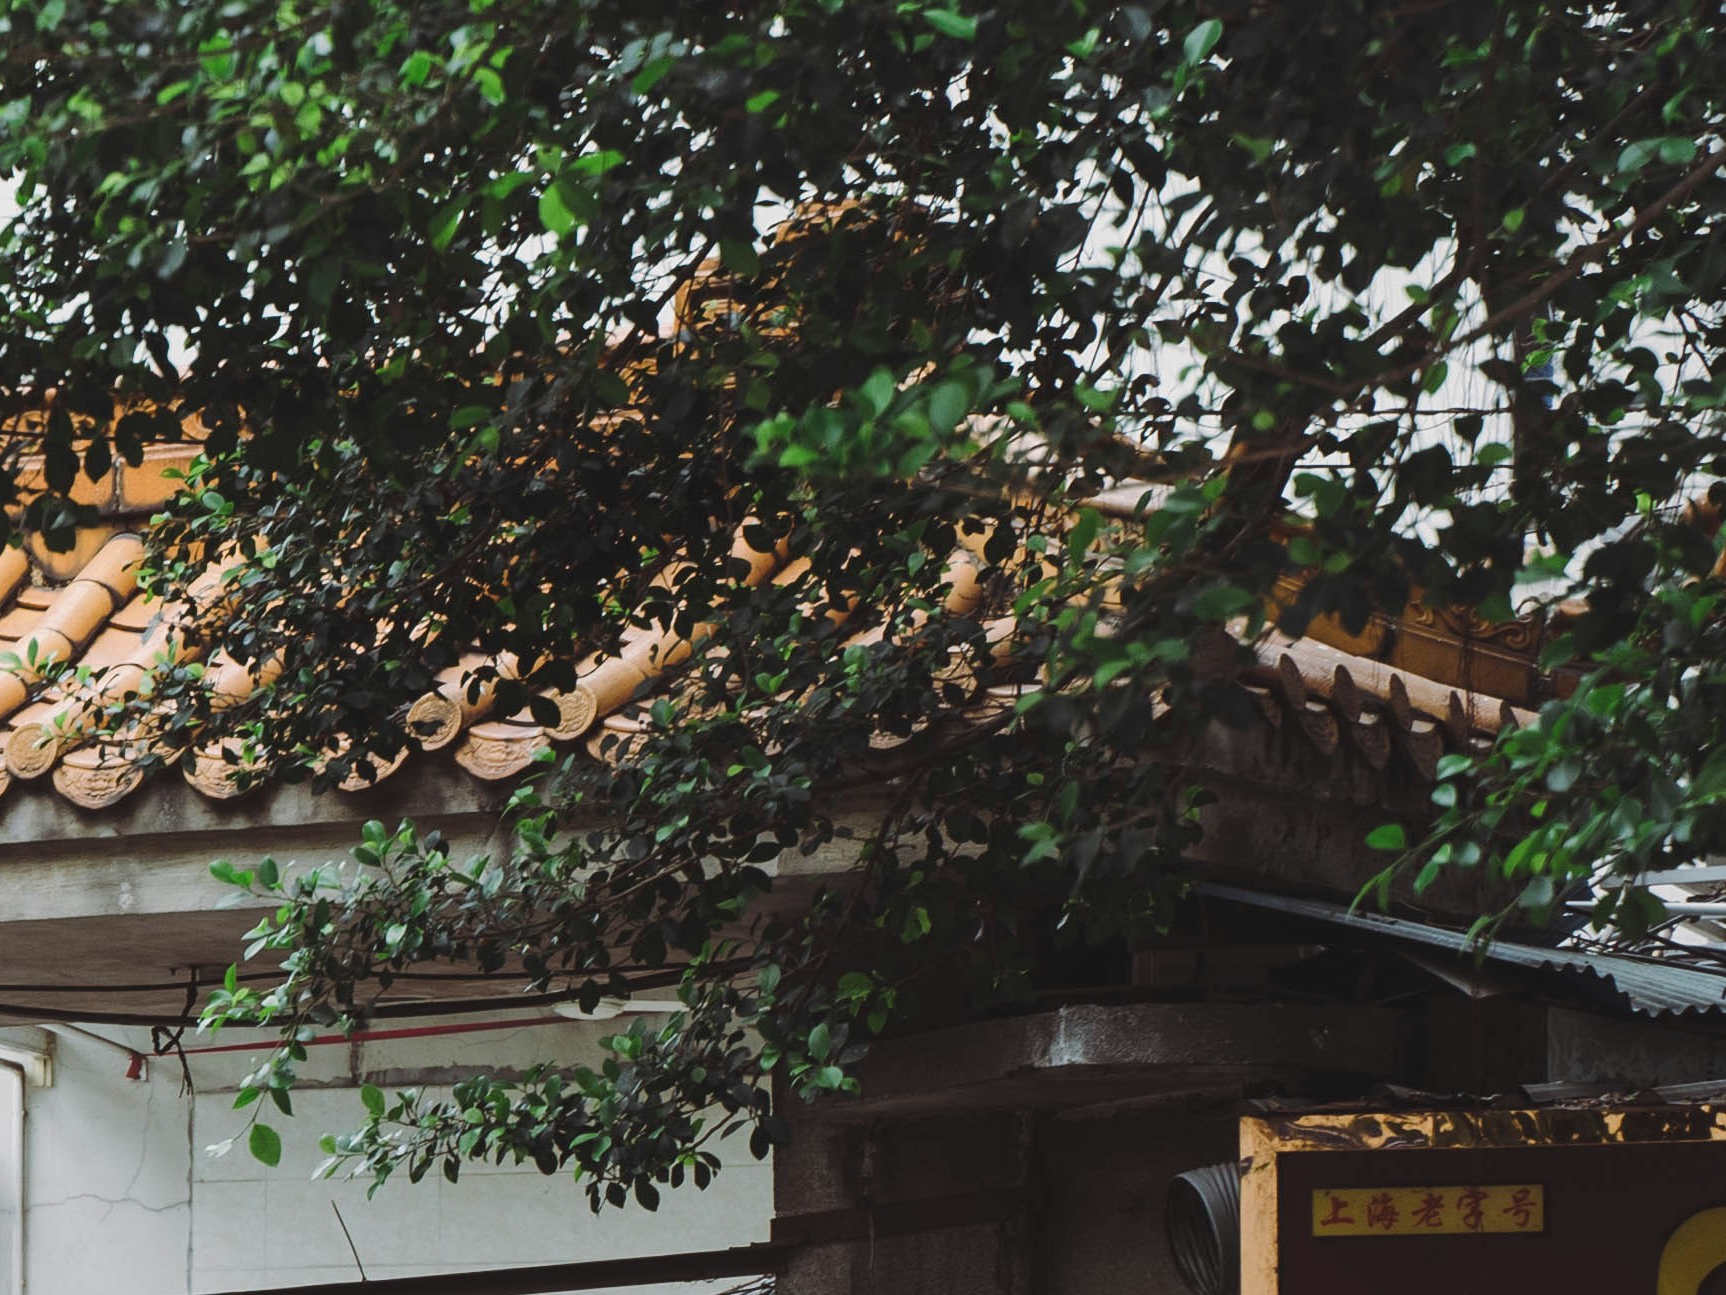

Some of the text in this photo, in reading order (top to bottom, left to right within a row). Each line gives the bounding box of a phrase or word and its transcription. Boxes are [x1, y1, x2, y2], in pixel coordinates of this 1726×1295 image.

[1320, 1188, 1537, 1231] 上海老字号
